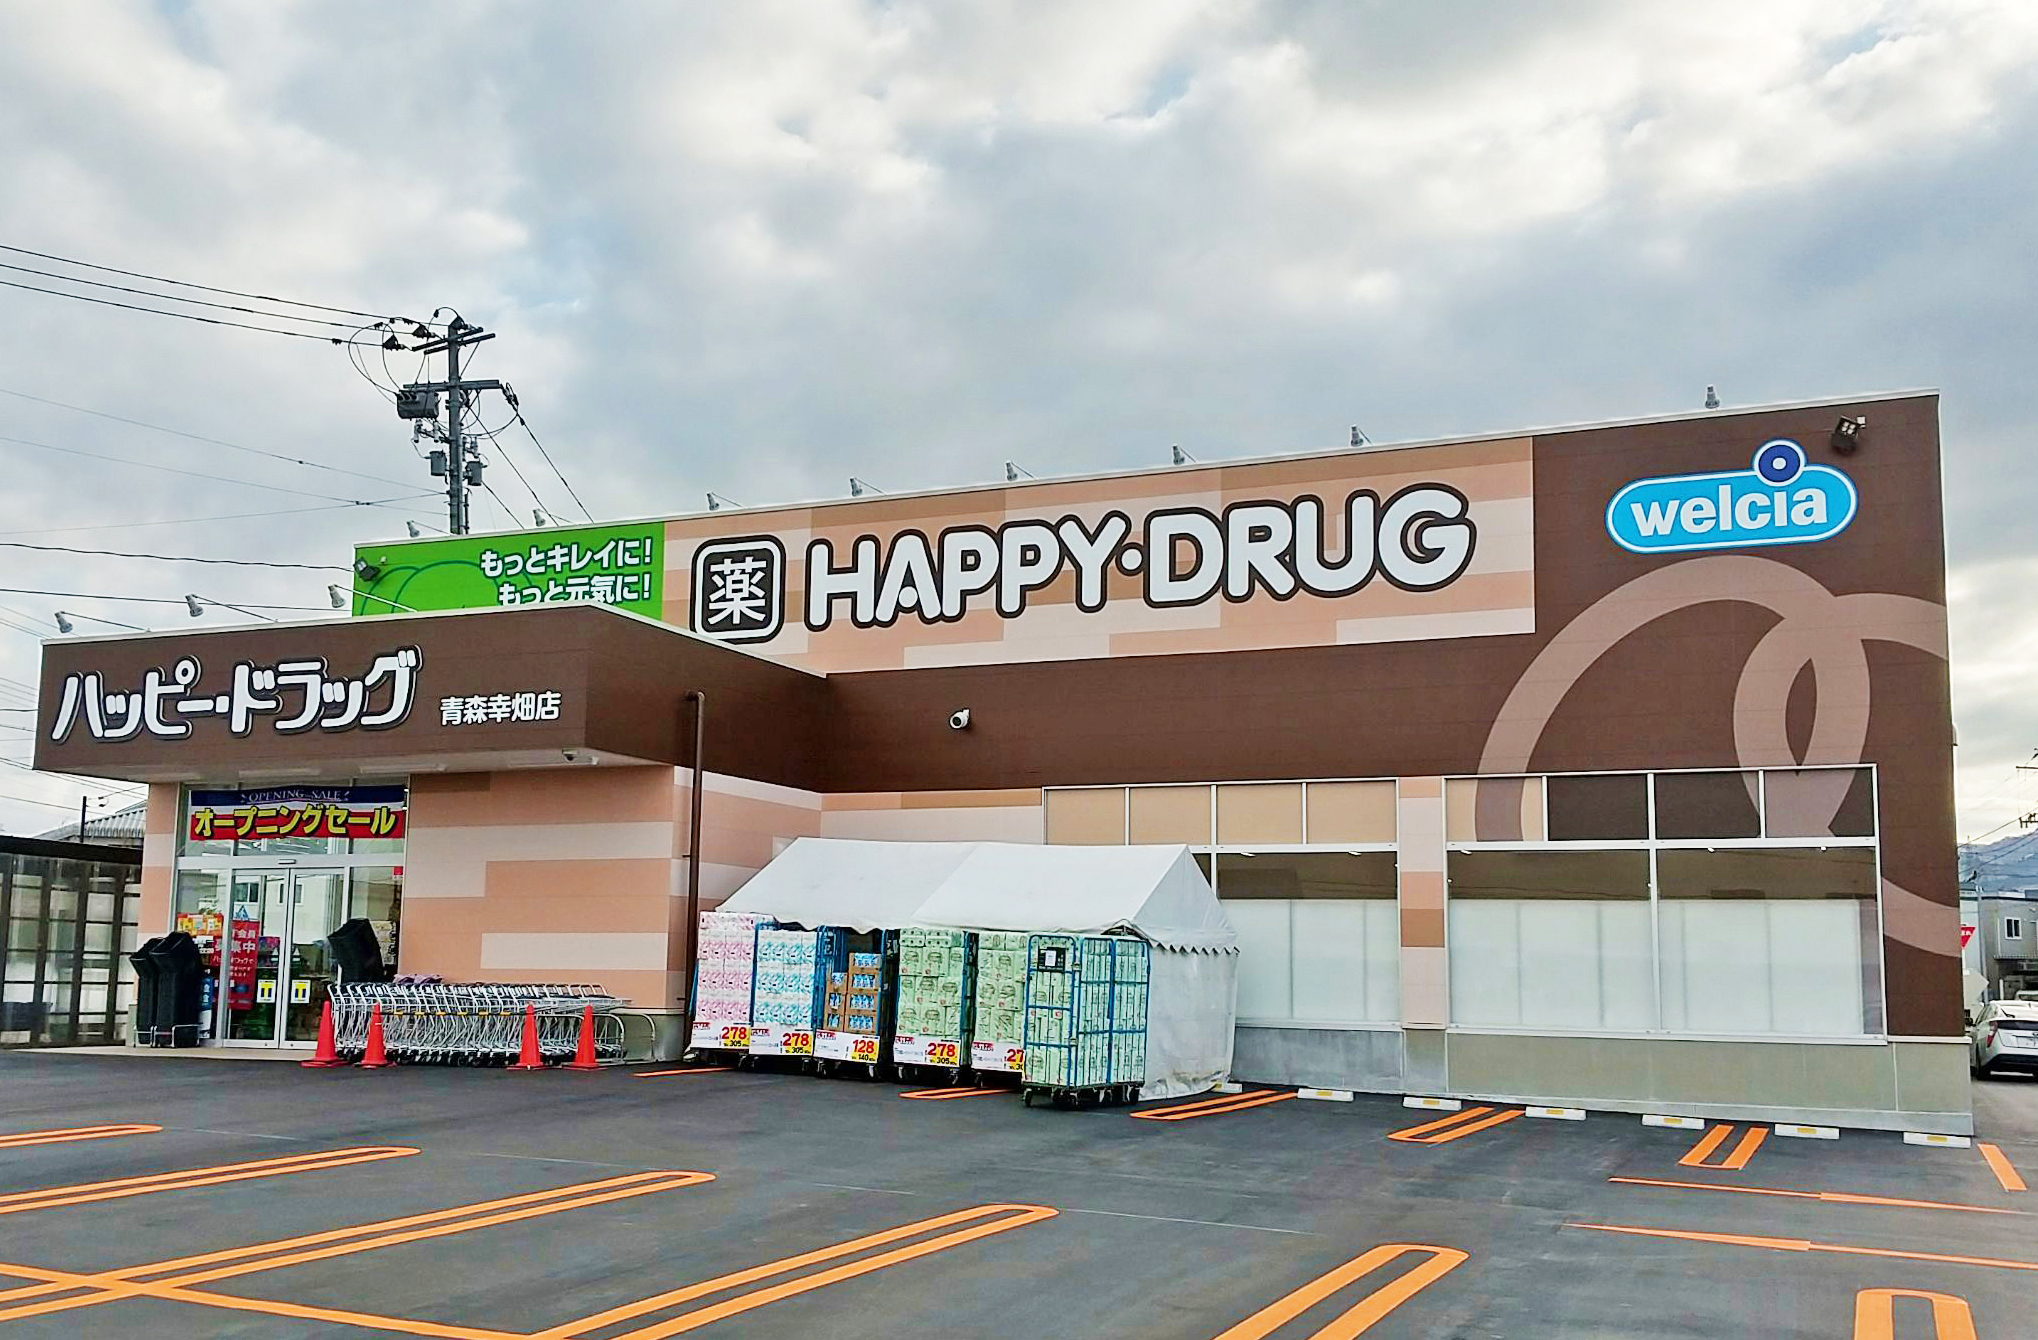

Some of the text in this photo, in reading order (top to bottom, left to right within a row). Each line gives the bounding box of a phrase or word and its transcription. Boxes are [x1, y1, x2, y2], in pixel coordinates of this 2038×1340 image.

[1629, 484, 1829, 537] welcia
[480, 537, 653, 578] もっとキレイに!
[498, 572, 652, 606] もっと元気に!
[707, 556, 767, 625] 薬
[439, 690, 562, 726] 青森幸畑店
[249, 789, 341, 802] OPENING SALE
[194, 804, 396, 837] オープニングセール
[721, 1026, 748, 1040] 278
[782, 1032, 810, 1047] 278
[729, 1040, 743, 1048] 305
[791, 1046, 805, 1054] 305
[852, 1039, 875, 1054] 128
[927, 1042, 956, 1057] 278
[858, 1053, 869, 1062] 140
[936, 1057, 950, 1065] 305
[1006, 1048, 1024, 1063] 27
